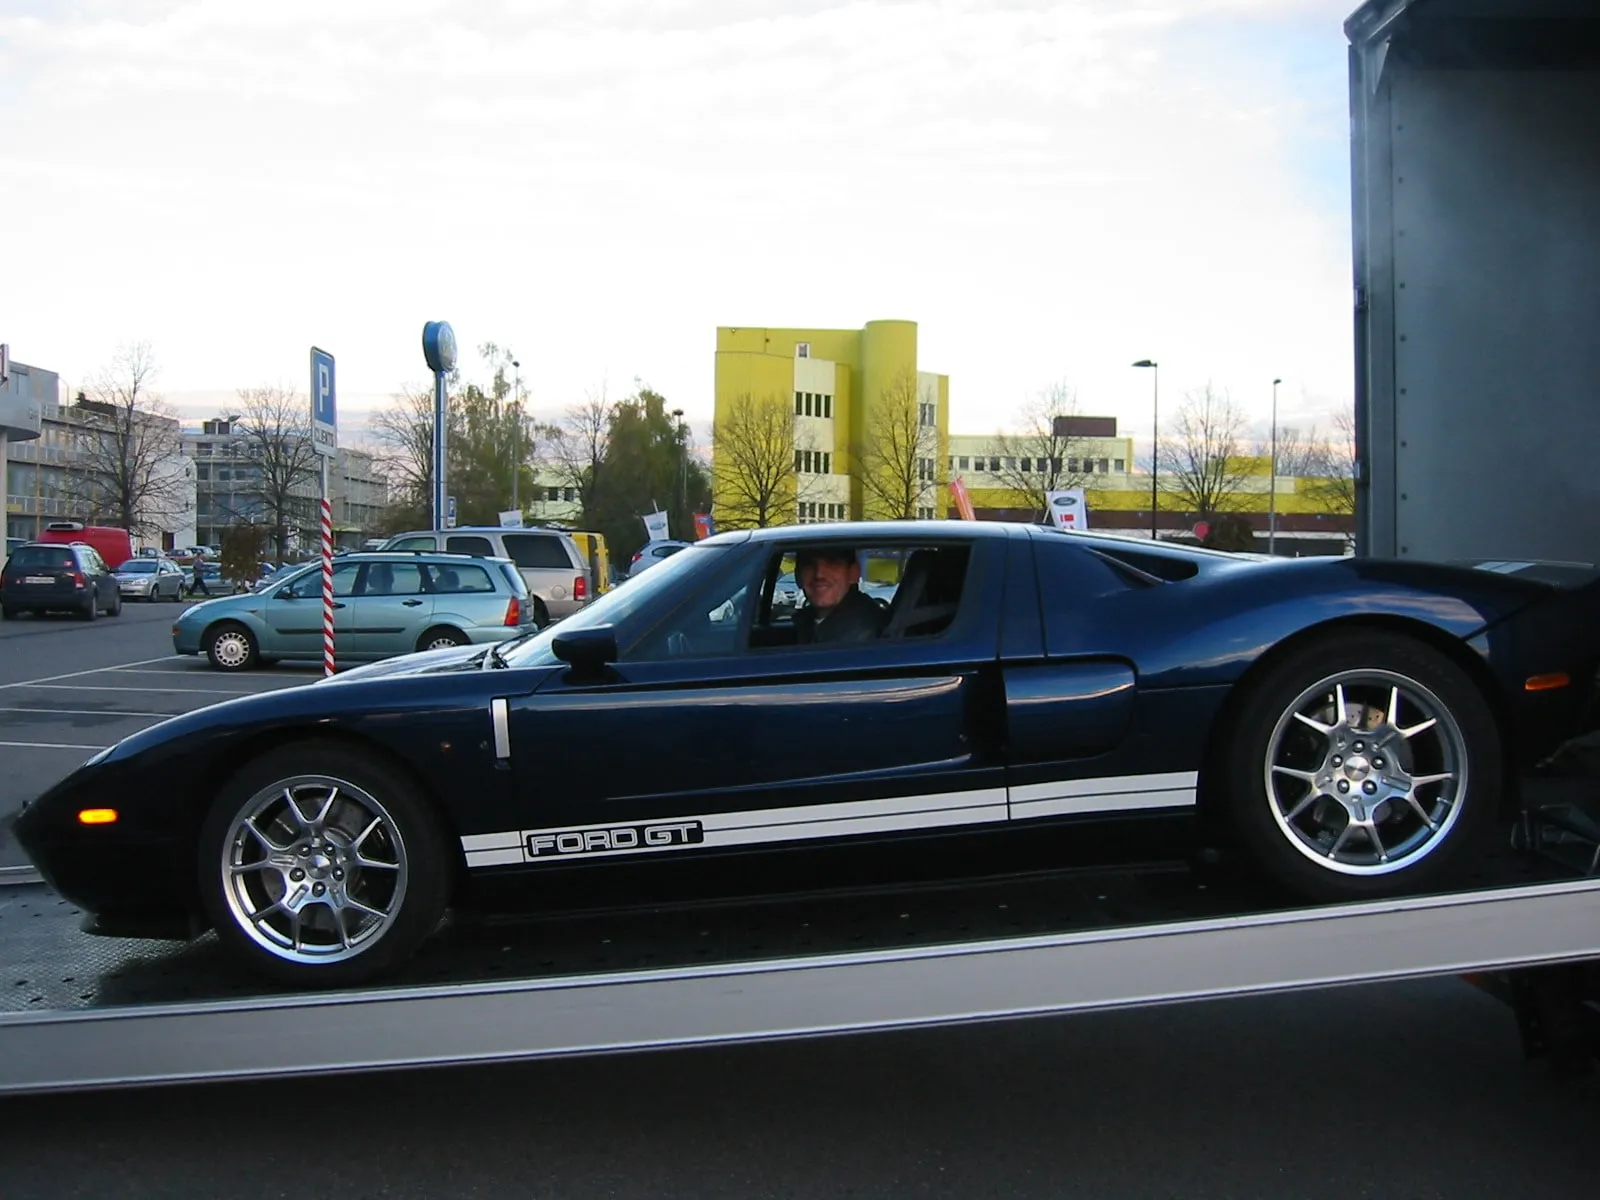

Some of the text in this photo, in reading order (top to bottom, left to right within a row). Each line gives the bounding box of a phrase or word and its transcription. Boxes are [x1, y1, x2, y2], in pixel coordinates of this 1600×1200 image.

[319, 363, 329, 412] P
[531, 823, 698, 855] FORD GT
